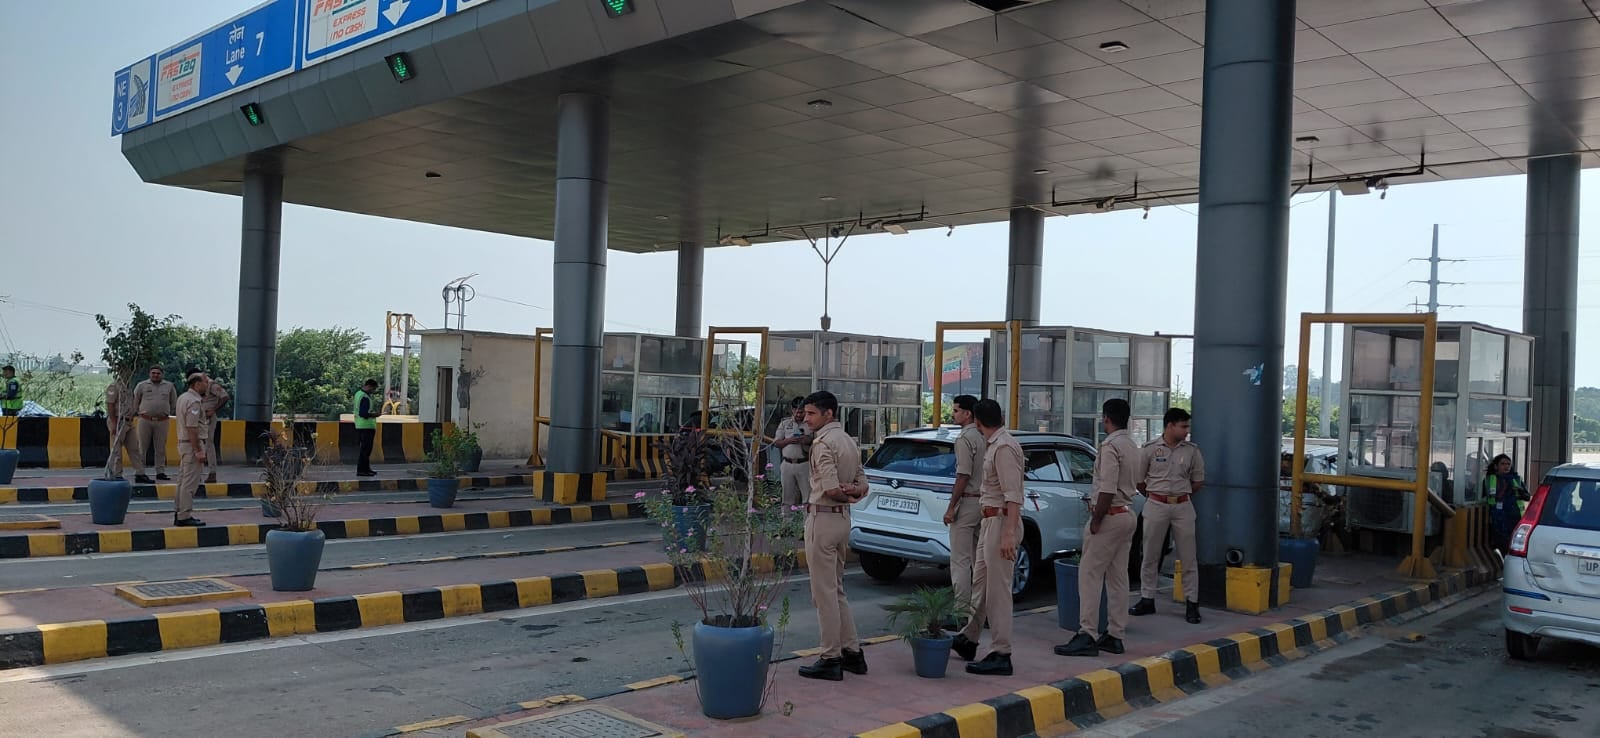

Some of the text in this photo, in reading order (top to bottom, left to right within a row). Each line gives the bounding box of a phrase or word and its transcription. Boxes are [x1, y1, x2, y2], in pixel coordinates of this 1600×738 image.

[228, 23, 245, 45] लेन
[226, 31, 265, 65] Lane 7
[117, 80, 127, 97] NE
[118, 102, 123, 121] 3
